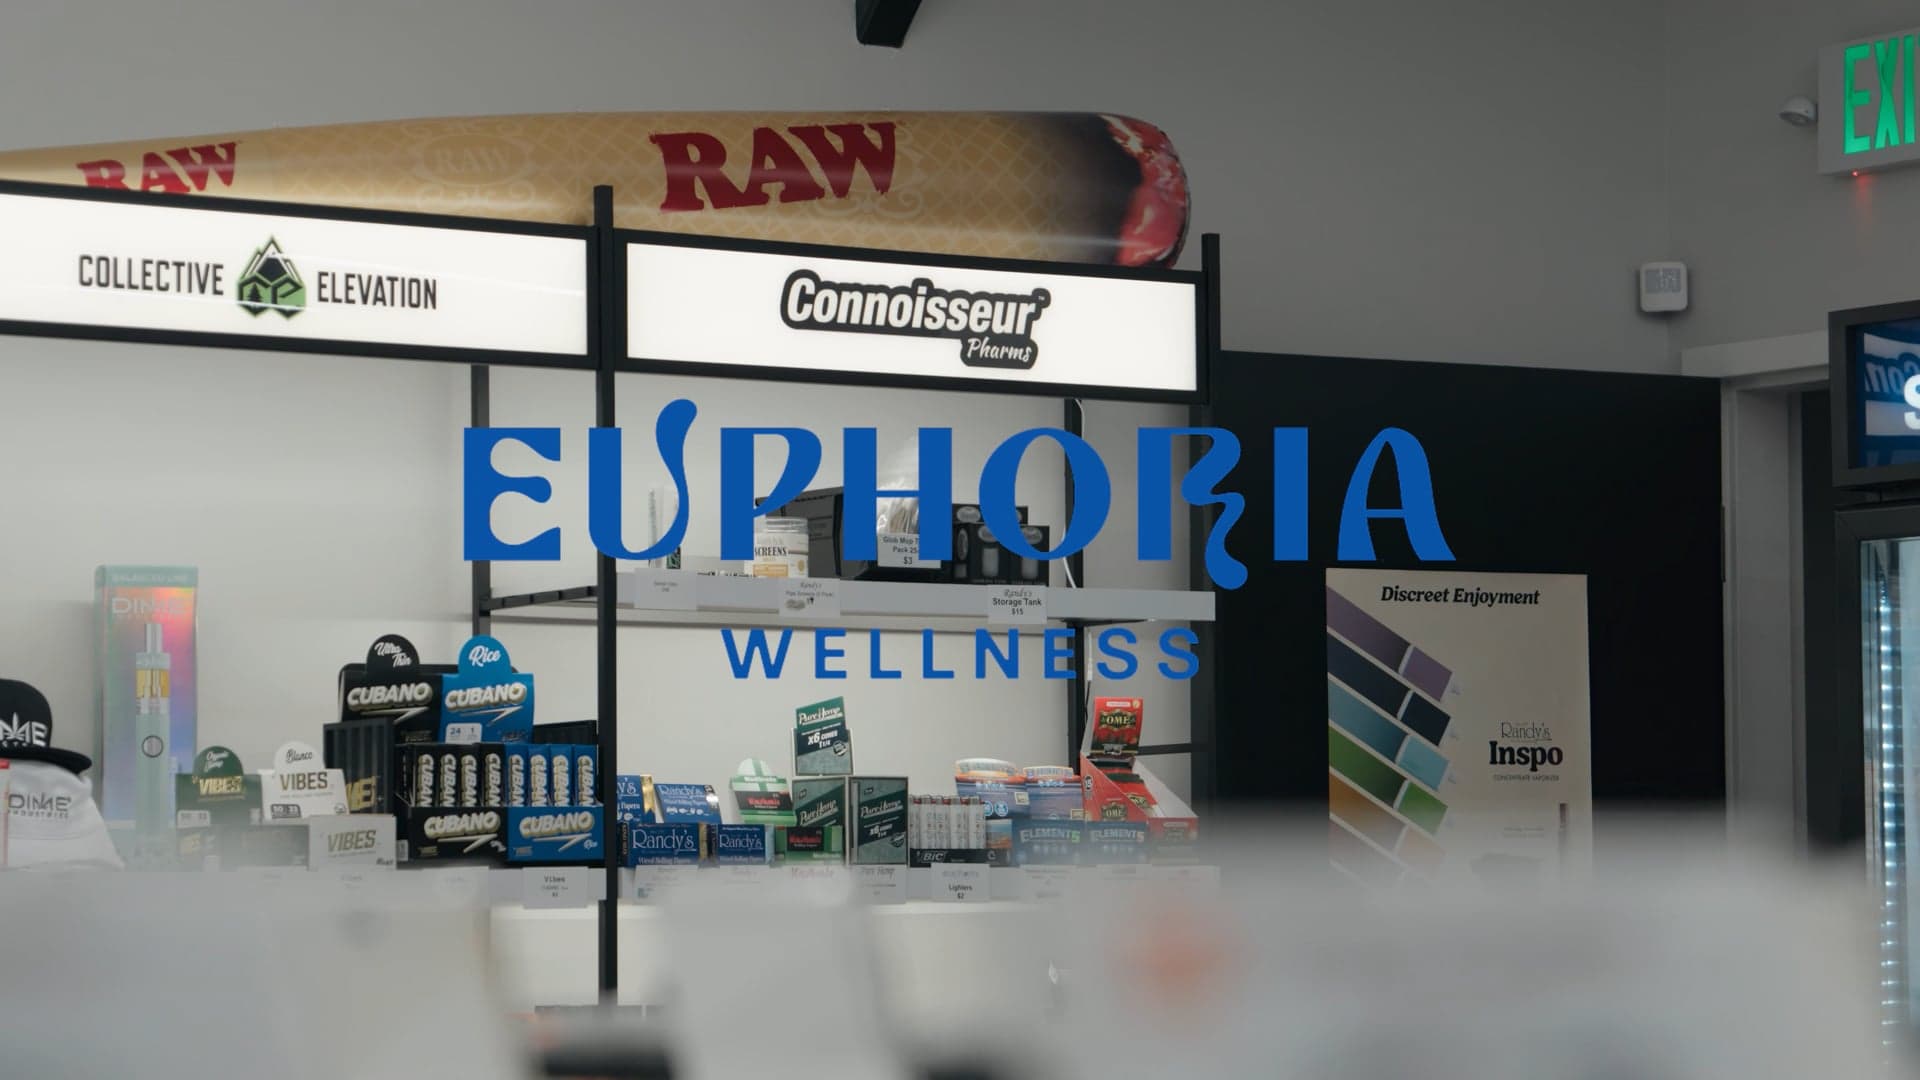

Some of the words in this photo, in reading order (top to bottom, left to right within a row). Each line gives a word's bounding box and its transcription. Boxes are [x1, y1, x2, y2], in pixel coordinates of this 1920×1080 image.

[1844, 34, 1920, 154] EXI
[76, 142, 237, 193] RAW
[649, 122, 895, 212] RAW
[78, 255, 224, 297] COLLECTIVE
[317, 271, 438, 310] ELEVATION
[787, 277, 1037, 334] Connoisseur
[967, 337, 1033, 363] Pharms
[992, 598, 1022, 607] Storage
[1025, 598, 1042, 606] Tank
[1381, 585, 1450, 603] Discreet
[1453, 587, 1541, 607] Enjoyment
[374, 642, 402, 657] Ultra
[392, 653, 412, 668] Thin
[469, 645, 501, 668] Rice
[347, 682, 433, 711] CUBANO
[445, 681, 528, 711] CUBANO
[1501, 721, 1552, 741] Randy's
[286, 749, 313, 764] Blanco
[1489, 740, 1564, 772] Inspo
[199, 776, 242, 795] VIBES
[280, 771, 328, 791] VIBES
[418, 754, 434, 806] CUBAN
[440, 753, 456, 806] CUBAN
[461, 754, 477, 806] CUBAN
[485, 753, 501, 806] CUBAN
[509, 754, 525, 806] CUBAN
[530, 754, 547, 806] CUBAN
[553, 755, 569, 806] CUBAN
[577, 755, 594, 806] CUBAN
[424, 810, 501, 839] CUBANO
[519, 811, 594, 839] CUBANO
[328, 830, 377, 852] VIBES
[632, 829, 696, 855] Randy's
[719, 834, 763, 850] Randy's
[948, 884, 973, 892] Lighters
